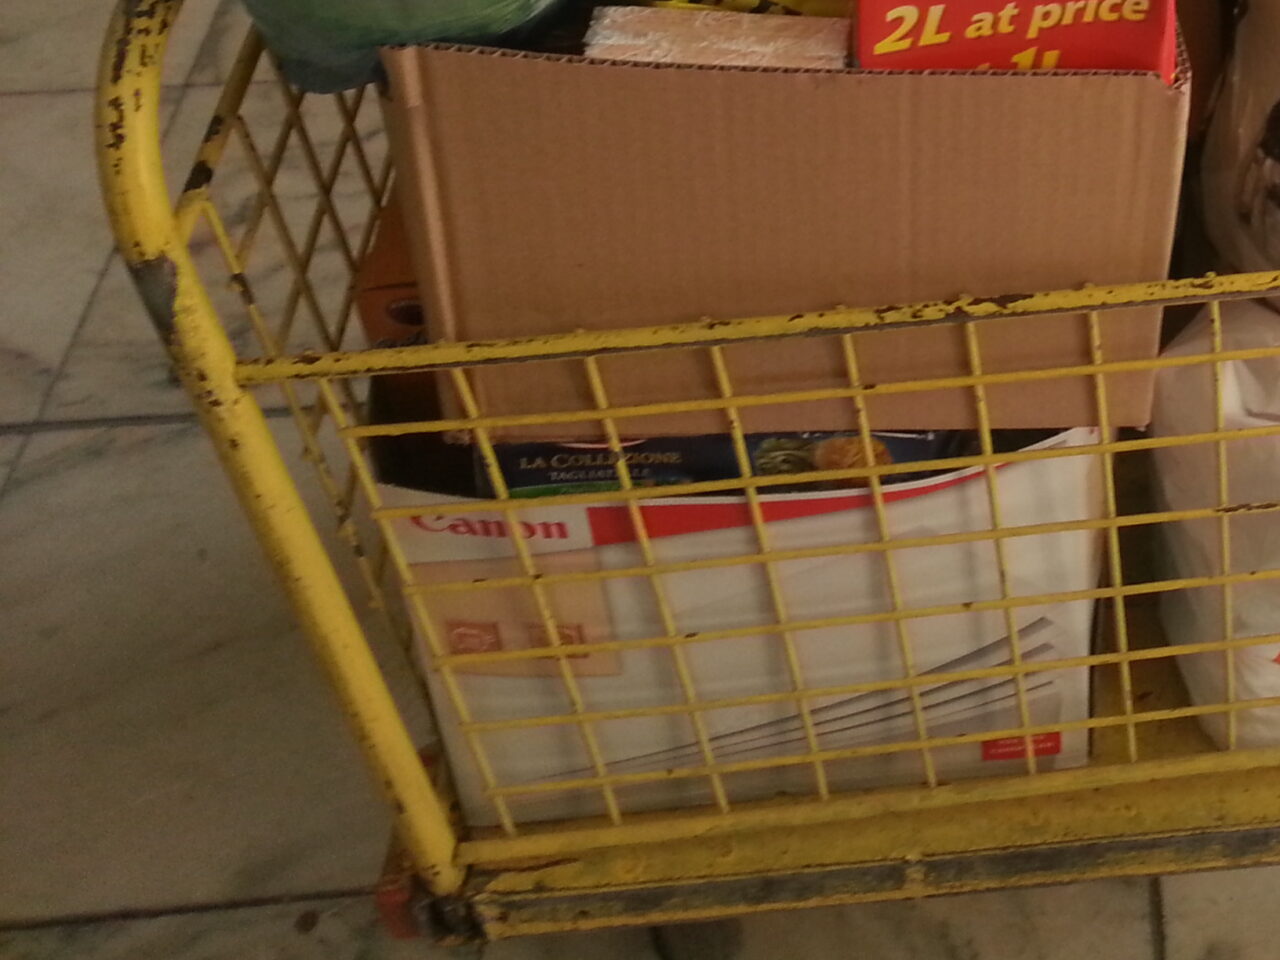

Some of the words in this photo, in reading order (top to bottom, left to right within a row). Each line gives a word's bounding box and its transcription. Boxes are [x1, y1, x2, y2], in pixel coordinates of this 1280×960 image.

[873, 4, 951, 55] 2L
[964, 2, 1020, 39] at
[519, 456, 547, 470] LA
[411, 515, 569, 539] Canon
